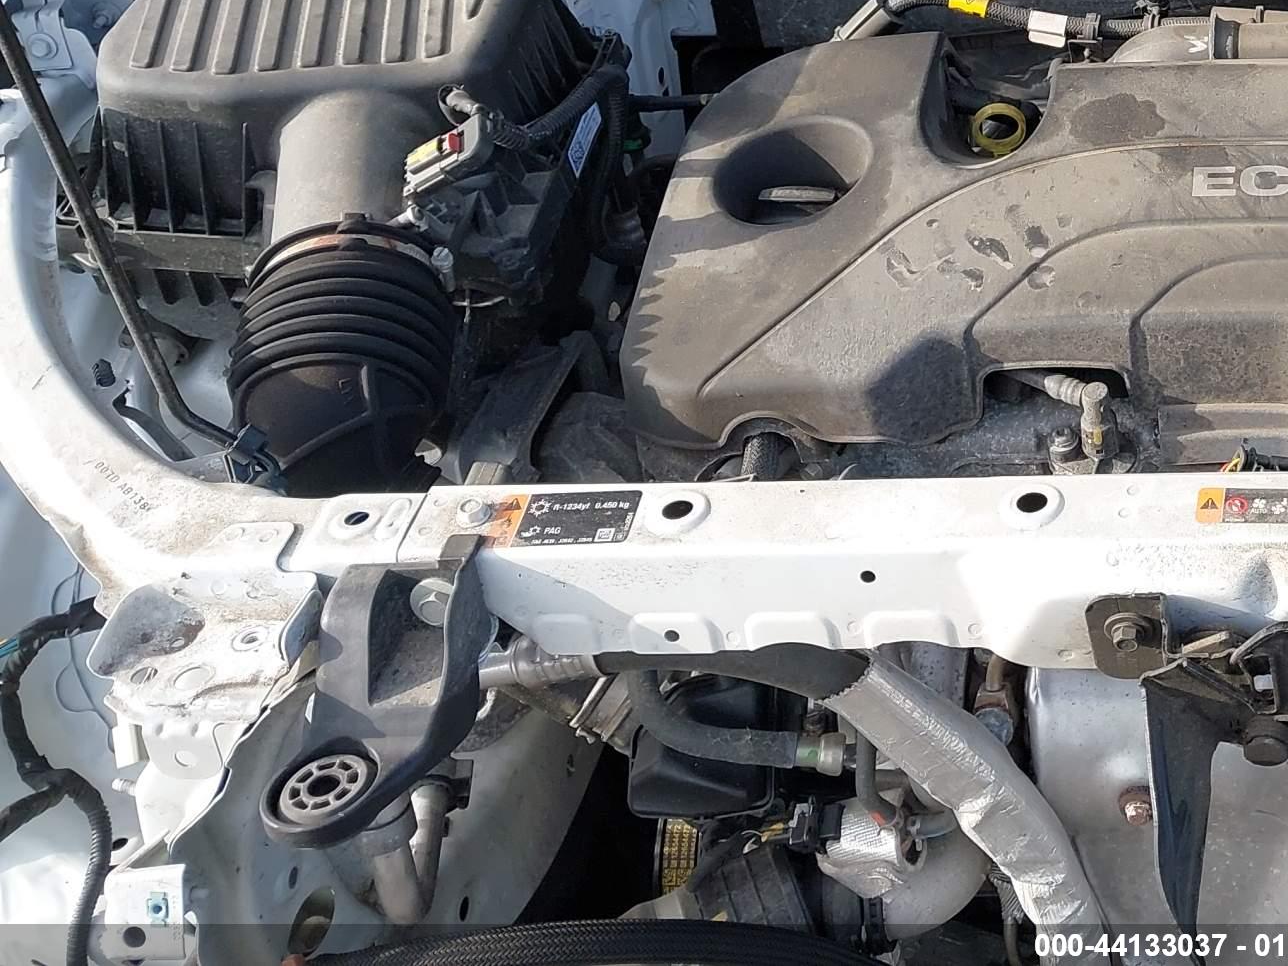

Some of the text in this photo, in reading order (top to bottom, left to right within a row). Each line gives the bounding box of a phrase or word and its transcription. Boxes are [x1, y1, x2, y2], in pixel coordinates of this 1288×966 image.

[553, 501, 630, 511] R-1234yf 0.450 kg
[544, 526, 561, 534] PAG
